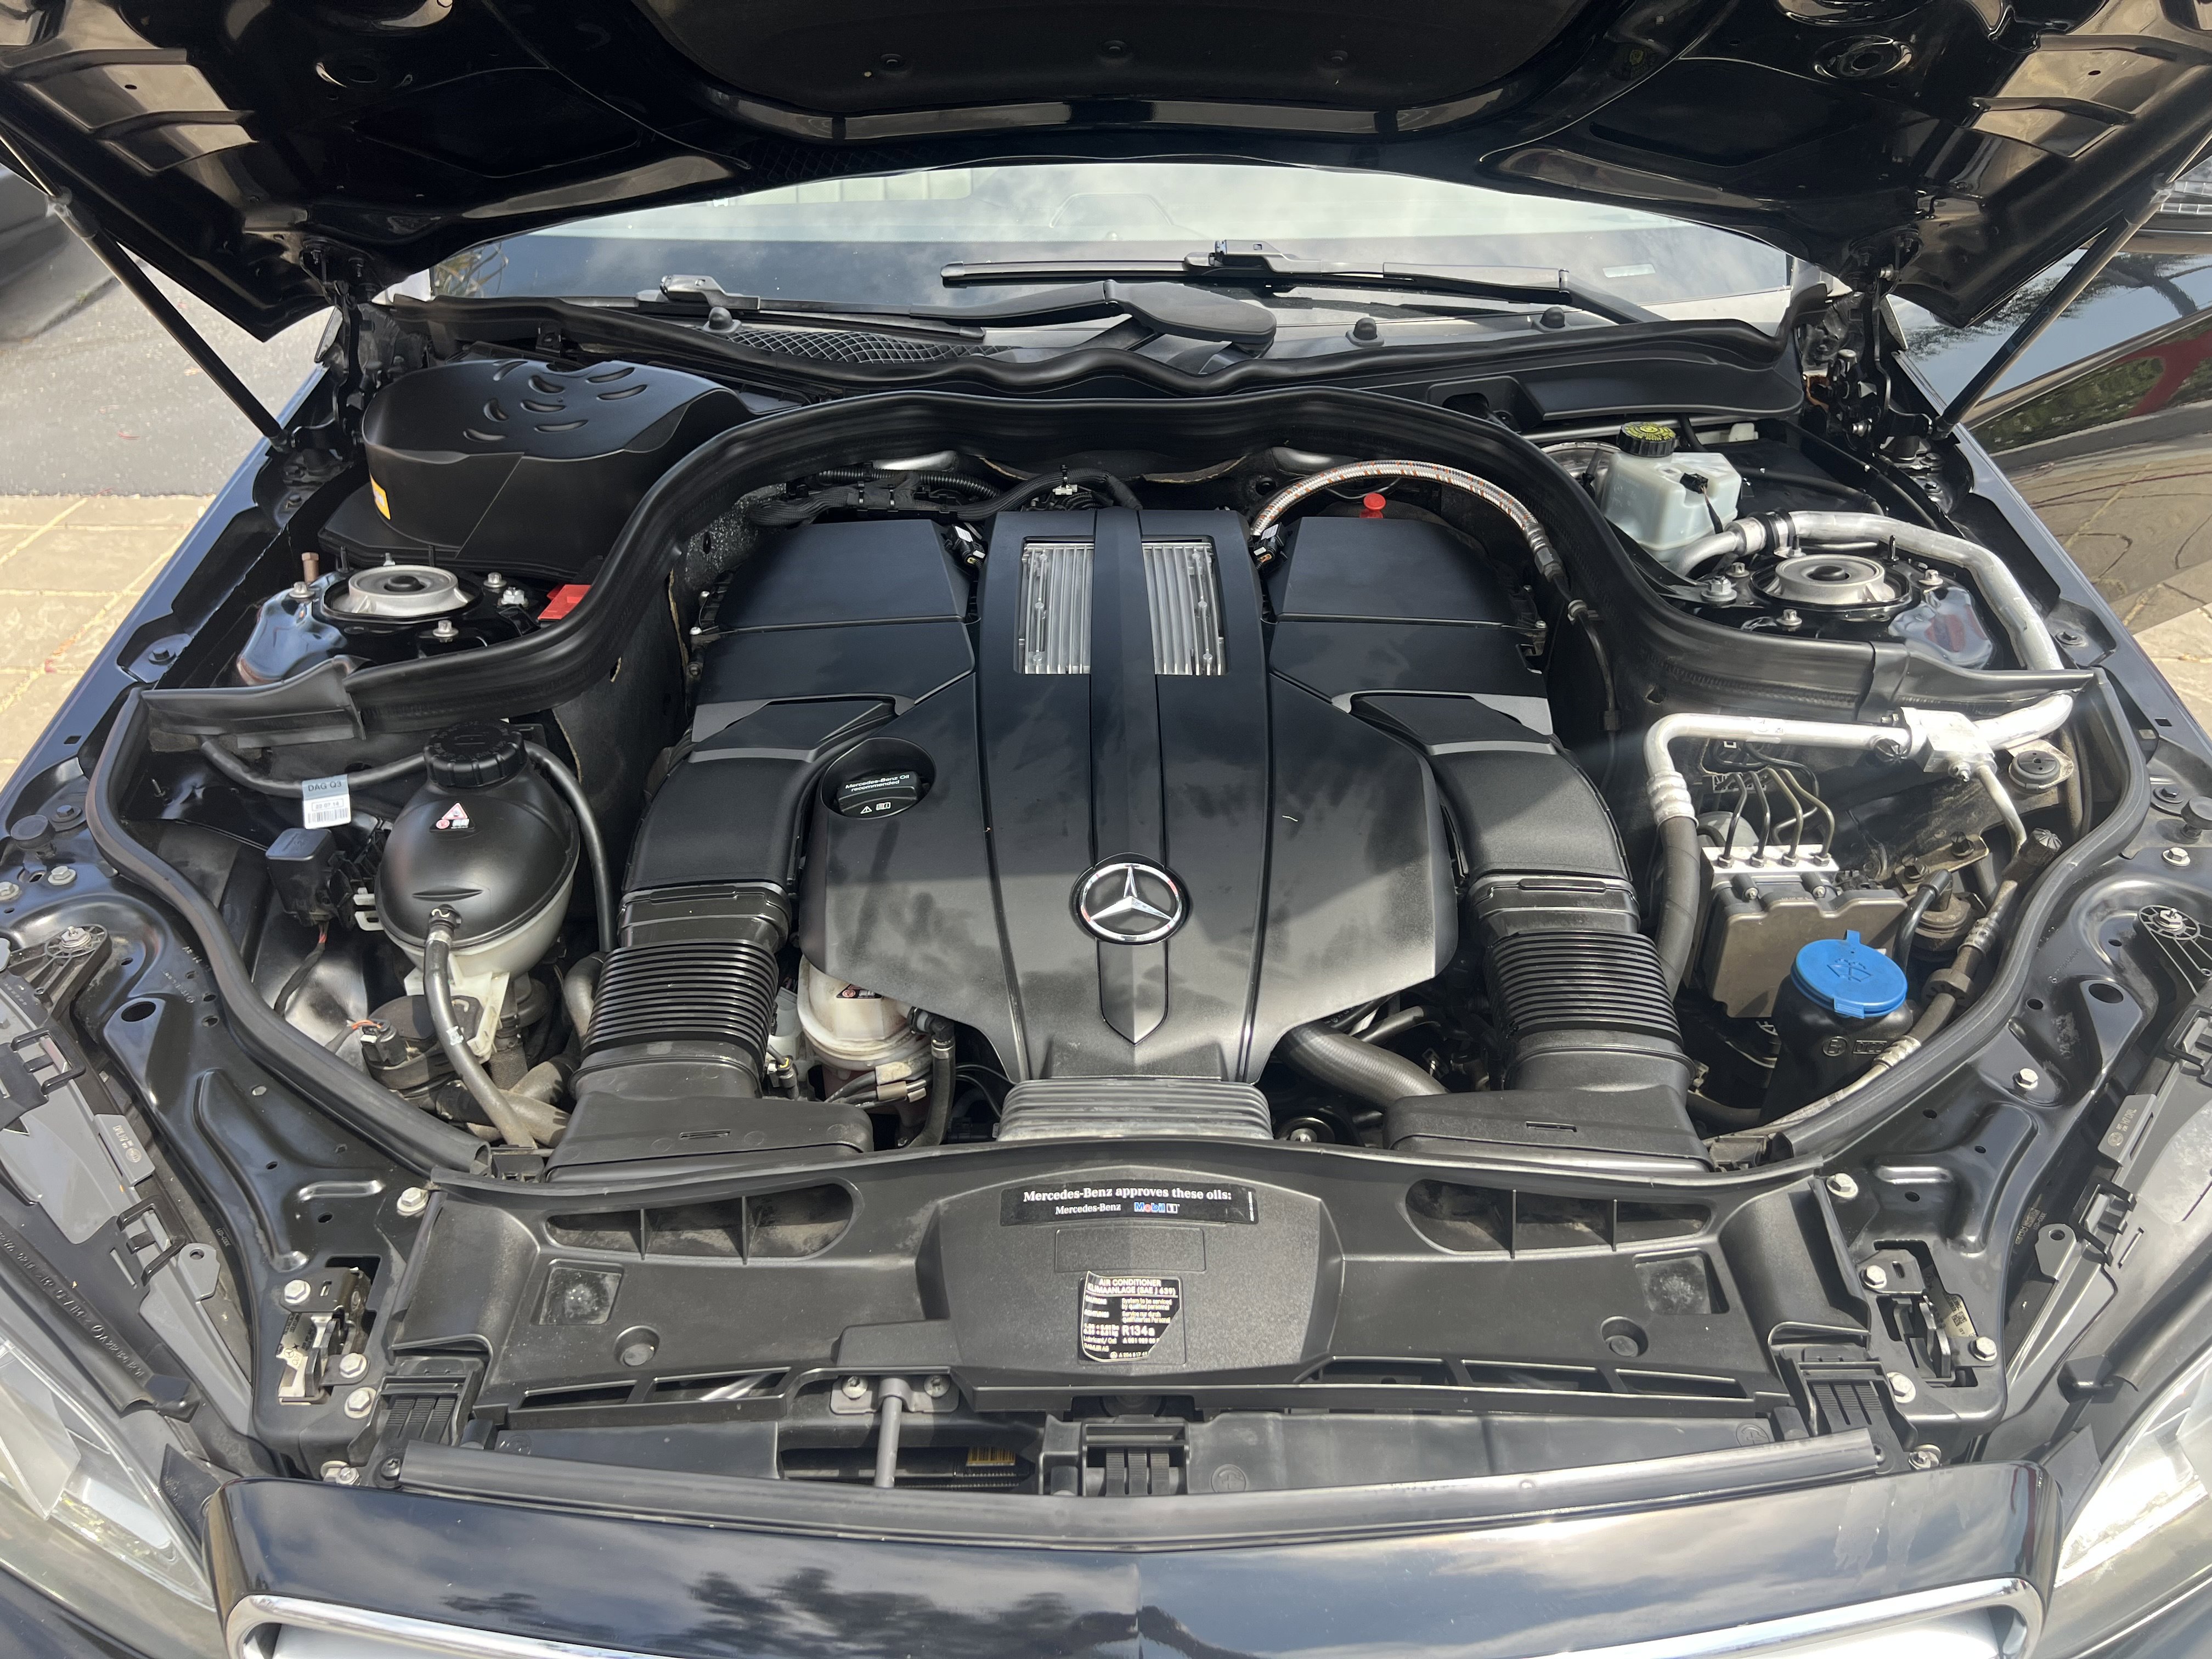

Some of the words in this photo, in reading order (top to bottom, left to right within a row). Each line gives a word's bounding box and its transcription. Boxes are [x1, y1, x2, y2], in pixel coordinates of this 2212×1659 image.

[308, 783, 328, 792] DAG
[845, 776, 898, 789] Mercedes-Benz
[851, 780, 900, 792] recommended
[1023, 1188, 1113, 1202] Mercedes-Benz
[1115, 1187, 1169, 1199] approves
[1172, 1188, 1204, 1200] these
[1206, 1189, 1232, 1200] oils:
[1055, 1203, 1121, 1215] Mercedes-Benz
[1134, 1201, 1166, 1213] Mobil
[1099, 1278, 1111, 1286] AIR
[1112, 1279, 1161, 1287] CONDITIONER
[1087, 1283, 1136, 1294] KLIMAANLAGE
[1137, 1287, 1153, 1295] (SAE
[1159, 1287, 1176, 1295] 639)
[1122, 1325, 1155, 1336] R134a
